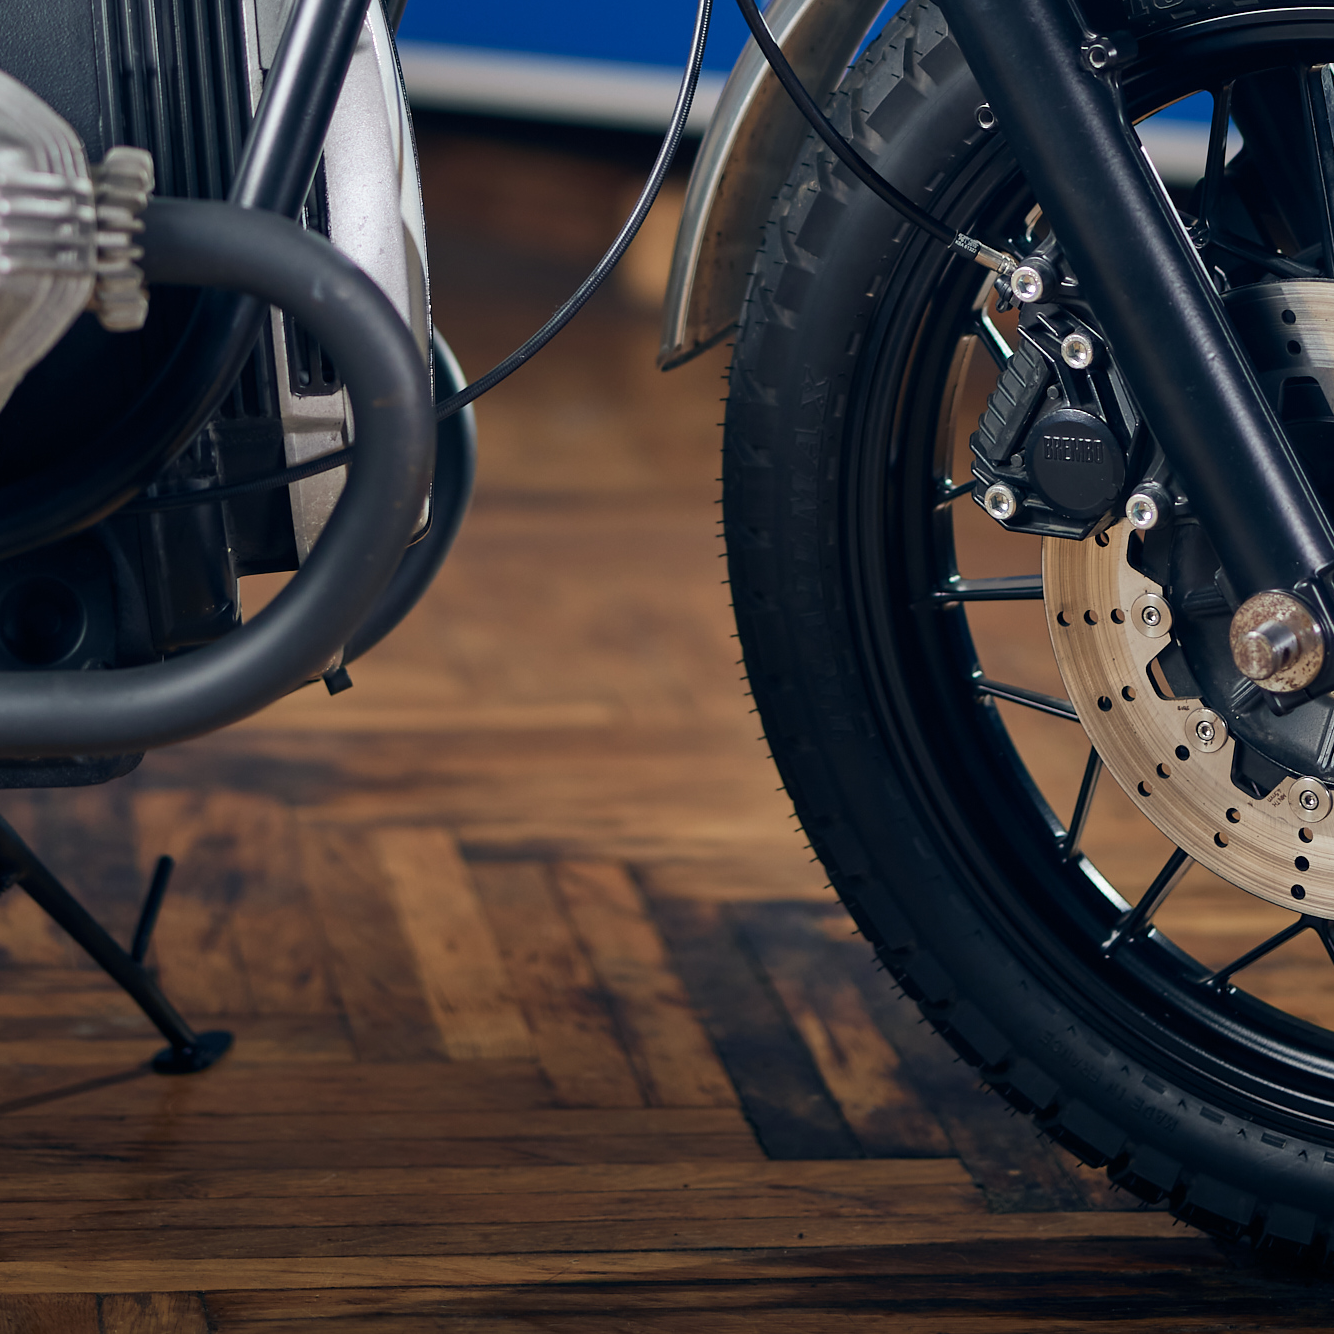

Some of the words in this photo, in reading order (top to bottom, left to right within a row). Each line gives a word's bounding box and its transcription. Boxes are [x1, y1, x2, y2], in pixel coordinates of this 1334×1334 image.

[1043, 435, 1104, 464] BREMBO
[1038, 1030, 1103, 1084] FRANCE
[1105, 1082, 1128, 1101] IN
[1129, 1094, 1180, 1133] MADE
